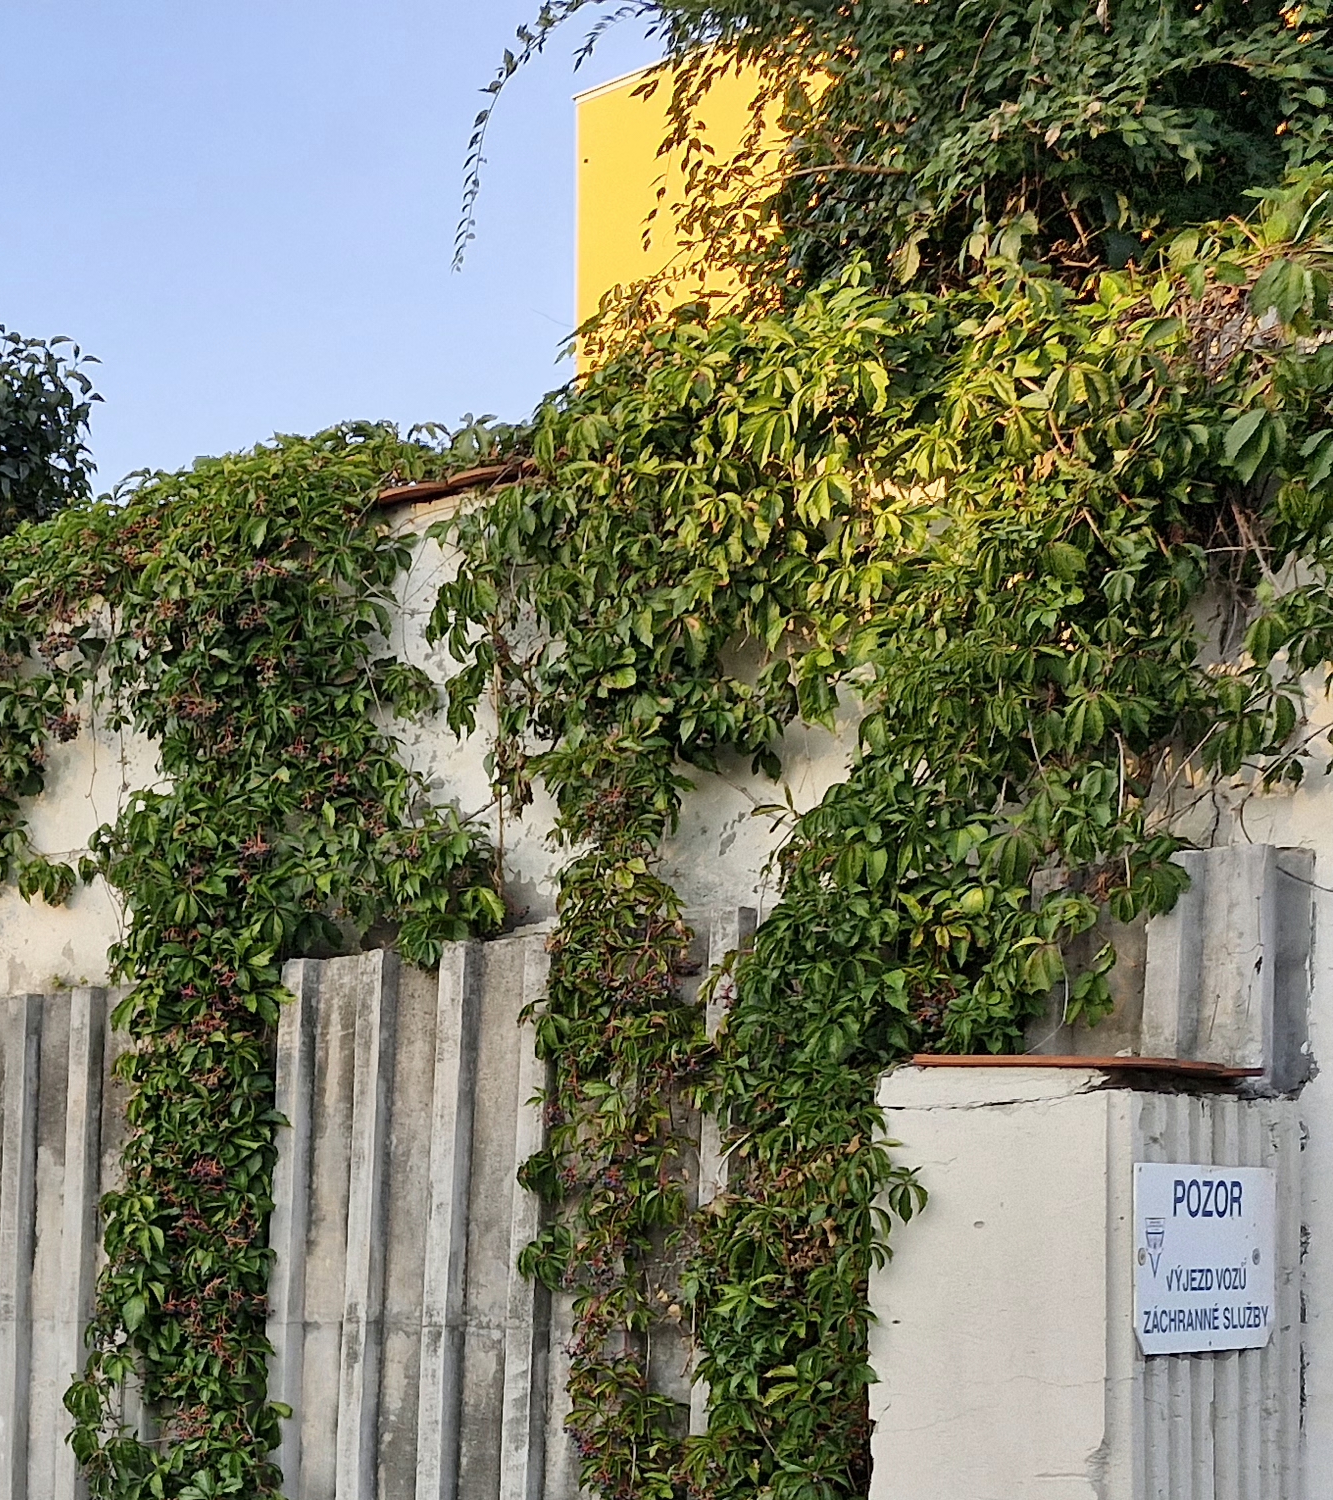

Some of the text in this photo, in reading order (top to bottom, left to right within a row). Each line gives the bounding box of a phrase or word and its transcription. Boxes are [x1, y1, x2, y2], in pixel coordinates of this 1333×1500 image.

[1172, 1178, 1243, 1219] POZOR
[1165, 1264, 1214, 1292] VÝJEZD
[1143, 1301, 1269, 1334] ZÁCHRANNÉ SLUŽBY
